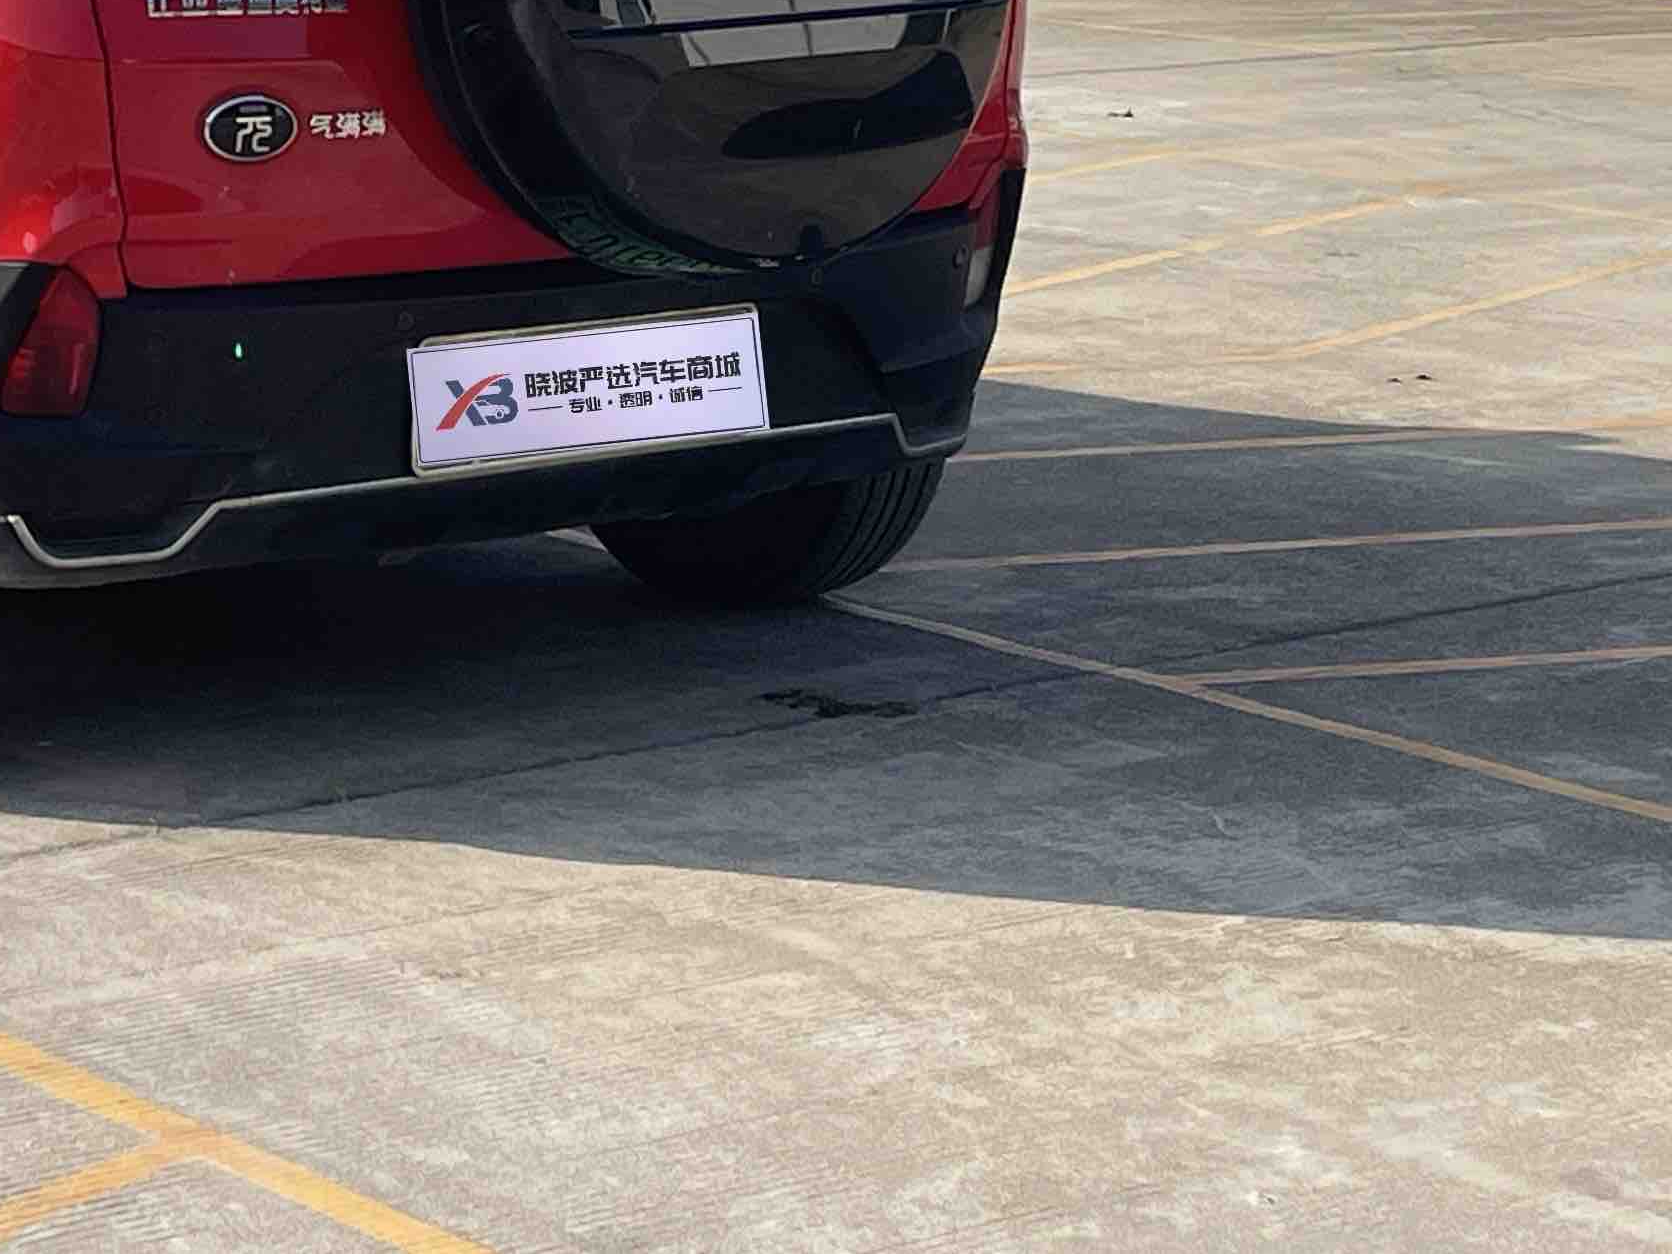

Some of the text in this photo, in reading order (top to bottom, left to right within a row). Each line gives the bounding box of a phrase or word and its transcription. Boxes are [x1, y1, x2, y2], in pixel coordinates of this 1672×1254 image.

[524, 351, 742, 399] 晓波严选汽车商城
